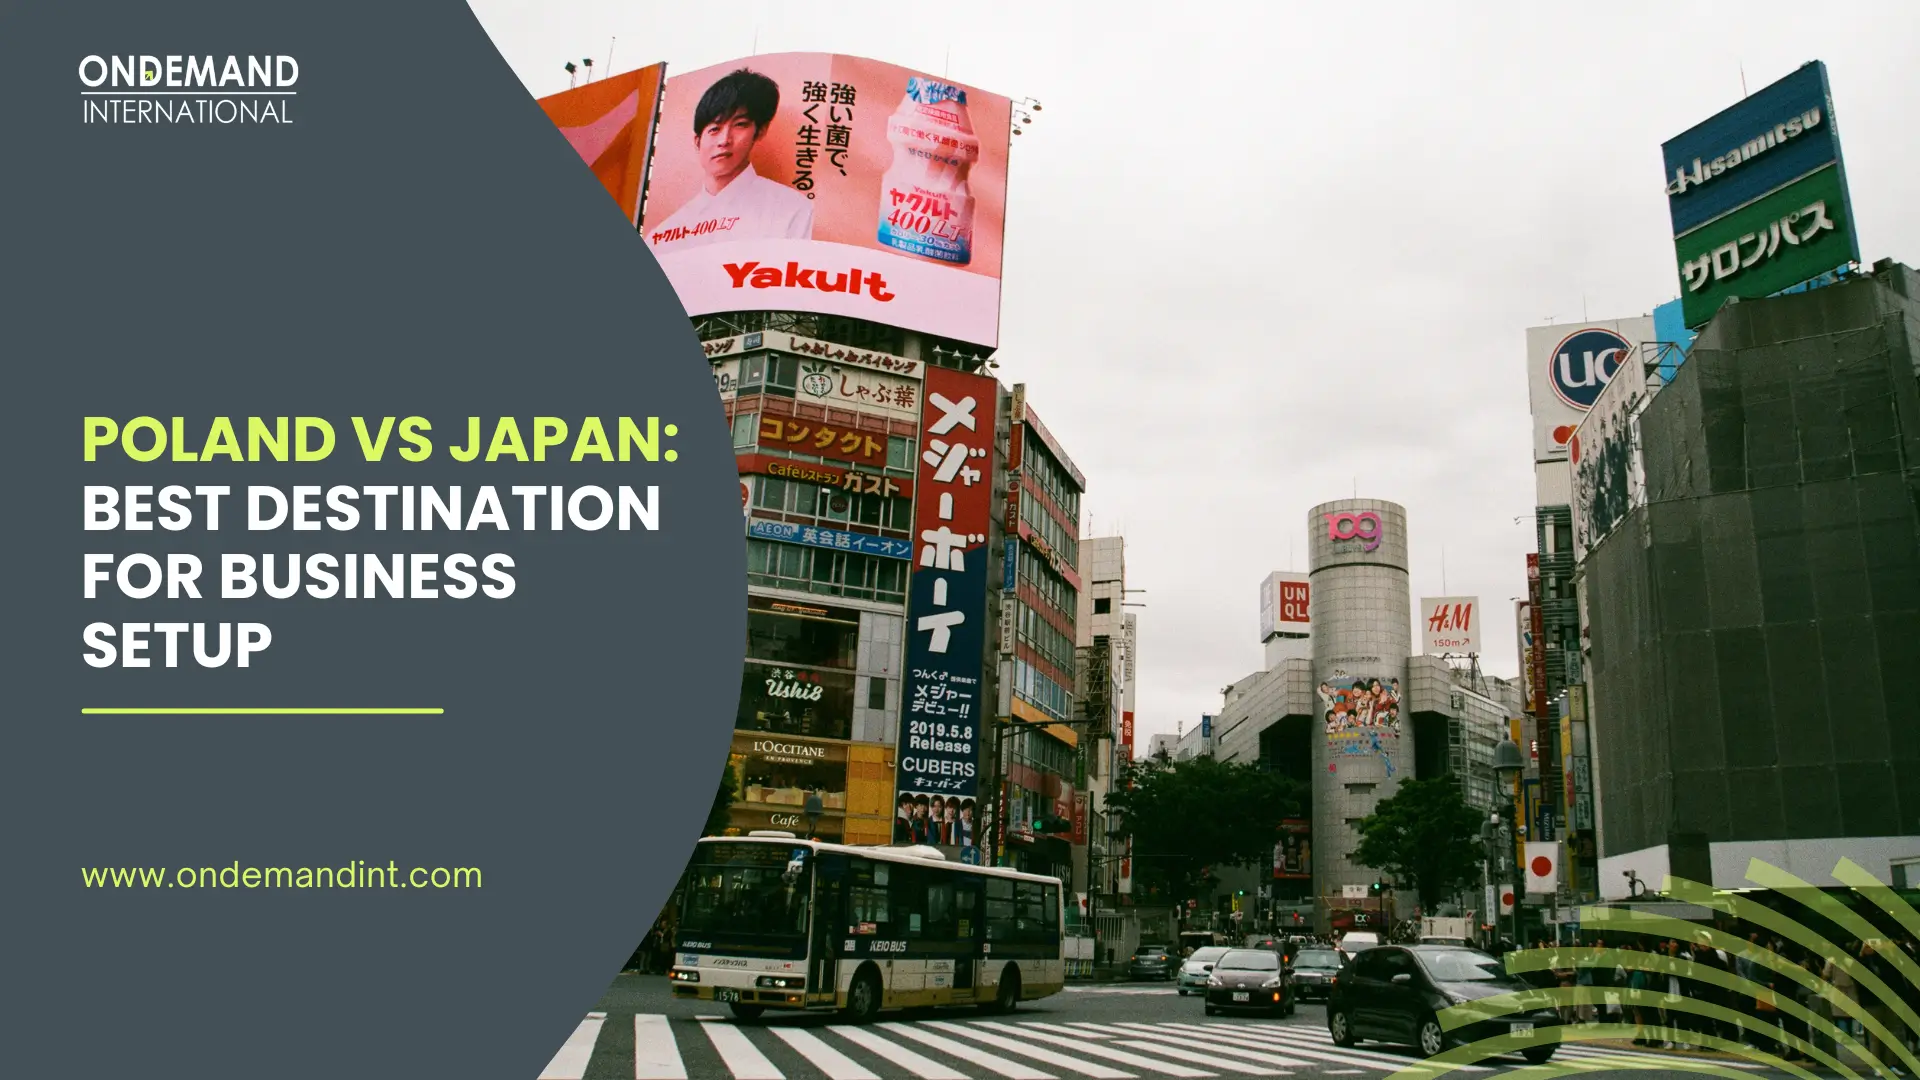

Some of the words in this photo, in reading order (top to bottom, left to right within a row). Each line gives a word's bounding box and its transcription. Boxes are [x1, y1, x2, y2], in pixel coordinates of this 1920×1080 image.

[792, 81, 827, 199] 強く生きる。
[825, 83, 856, 176] 強い菌で、
[1665, 106, 1820, 195] Hisamitsu
[890, 188, 957, 220] ヤクルト
[888, 209, 965, 242] 400LT
[1682, 200, 1834, 292] サロンパス
[723, 262, 895, 302] Yakult
[790, 336, 917, 374] しゃぶしゃぶバイキング
[839, 374, 915, 408] しゃぶ葉
[760, 417, 883, 457] コンタクト
[843, 471, 899, 497] ガスト
[755, 522, 793, 538] AEON
[917, 391, 987, 654] メジャーボーイ
[1323, 511, 1382, 551] 109
[1284, 586, 1306, 600] UN
[1428, 603, 1472, 633] H&M
[771, 667, 795, 680] 渋谷
[765, 679, 823, 701] Ushi8
[914, 683, 972, 700] メジャー
[910, 720, 972, 739] 2019.5.8
[910, 735, 971, 754] Release
[902, 756, 975, 777] CUBERS
[770, 813, 799, 829] Café
[869, 940, 889, 952] KEIO
[890, 941, 907, 952] BUS
